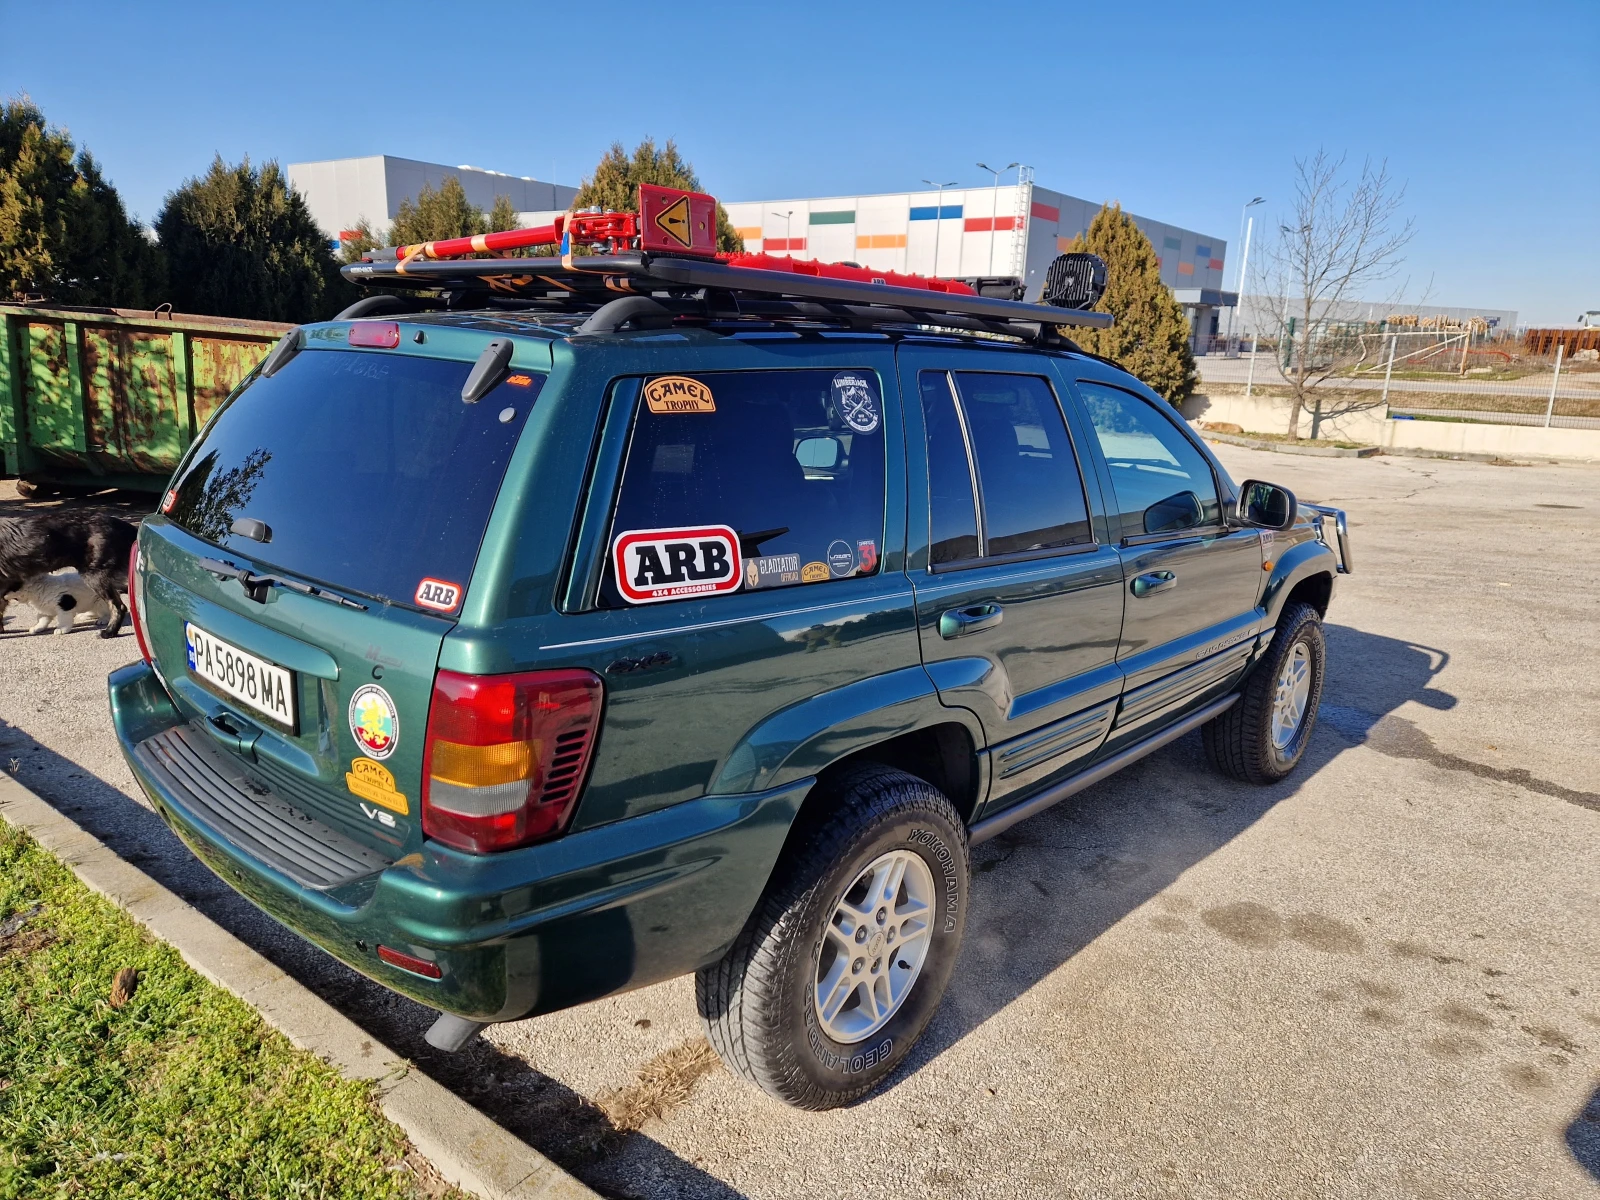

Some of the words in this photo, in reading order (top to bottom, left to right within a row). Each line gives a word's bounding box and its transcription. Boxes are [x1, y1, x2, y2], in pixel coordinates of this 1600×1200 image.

[506, 374, 532, 386] KTM
[650, 382, 710, 403] CAMEL
[664, 400, 700, 410] TROPHY
[634, 540, 730, 587] ARB
[760, 556, 798, 574] GLADIATOR
[804, 565, 828, 576] CAMEL
[419, 583, 456, 605] ARB
[652, 588, 669, 597] 4X4
[671, 583, 717, 595] ACCESSORIES
[356, 764, 393, 787] CAMEL
[908, 828, 960, 934] YOKOHAMA
[805, 981, 893, 1075] GEOLANDAR
